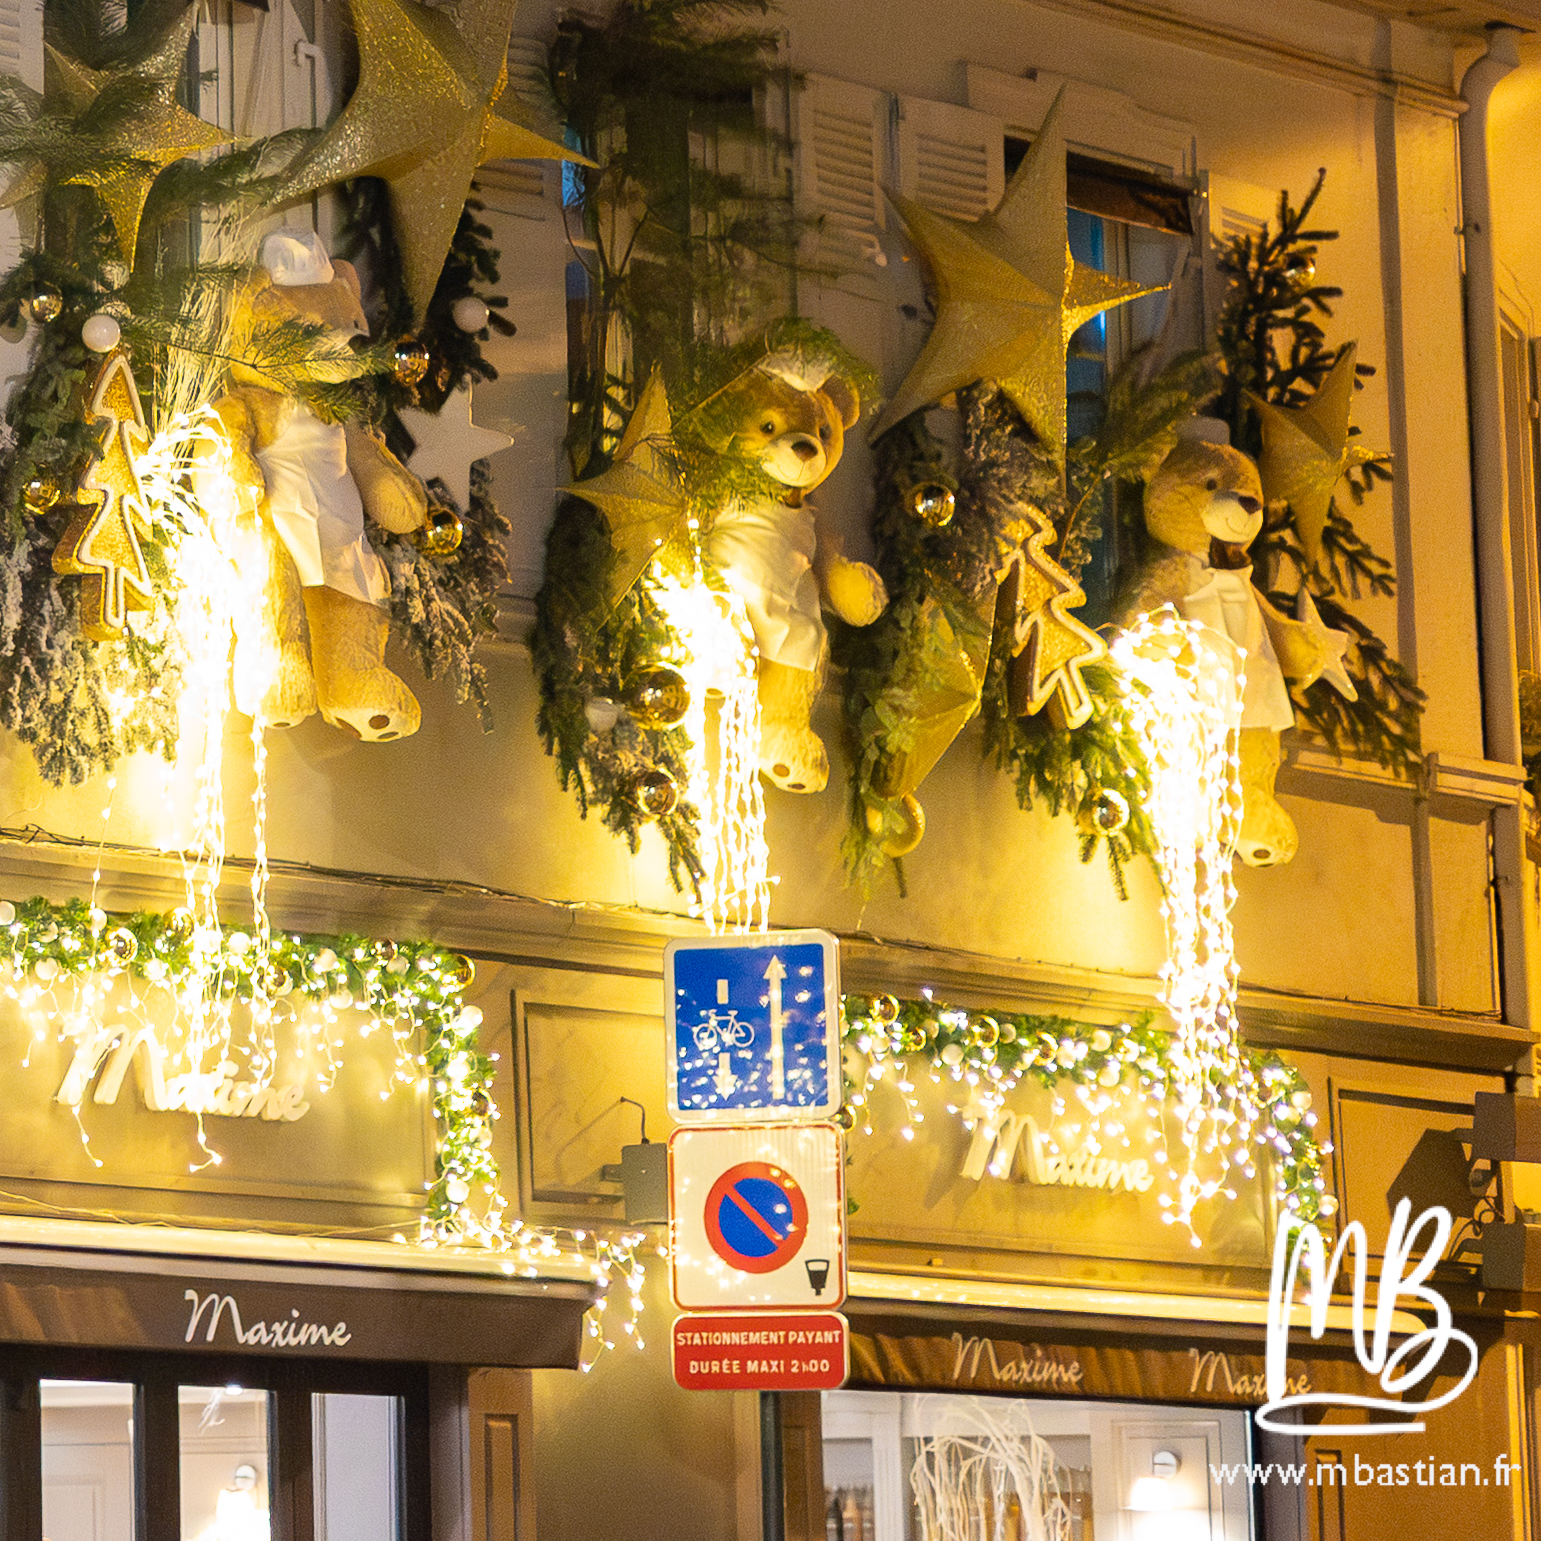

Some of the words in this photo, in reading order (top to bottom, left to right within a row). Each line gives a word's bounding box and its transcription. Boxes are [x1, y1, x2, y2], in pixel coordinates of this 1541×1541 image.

[184, 1288, 352, 1348] Maxime
[676, 1331, 786, 1346] STATIONNEMENT
[788, 1330, 841, 1345] PAYANT
[689, 1358, 741, 1374] DURÉE
[747, 1360, 784, 1374] MAXI
[791, 1359, 830, 1373] 2h00
[952, 1331, 1083, 1385] Maxime
[1189, 1347, 1312, 1398] Maxe
